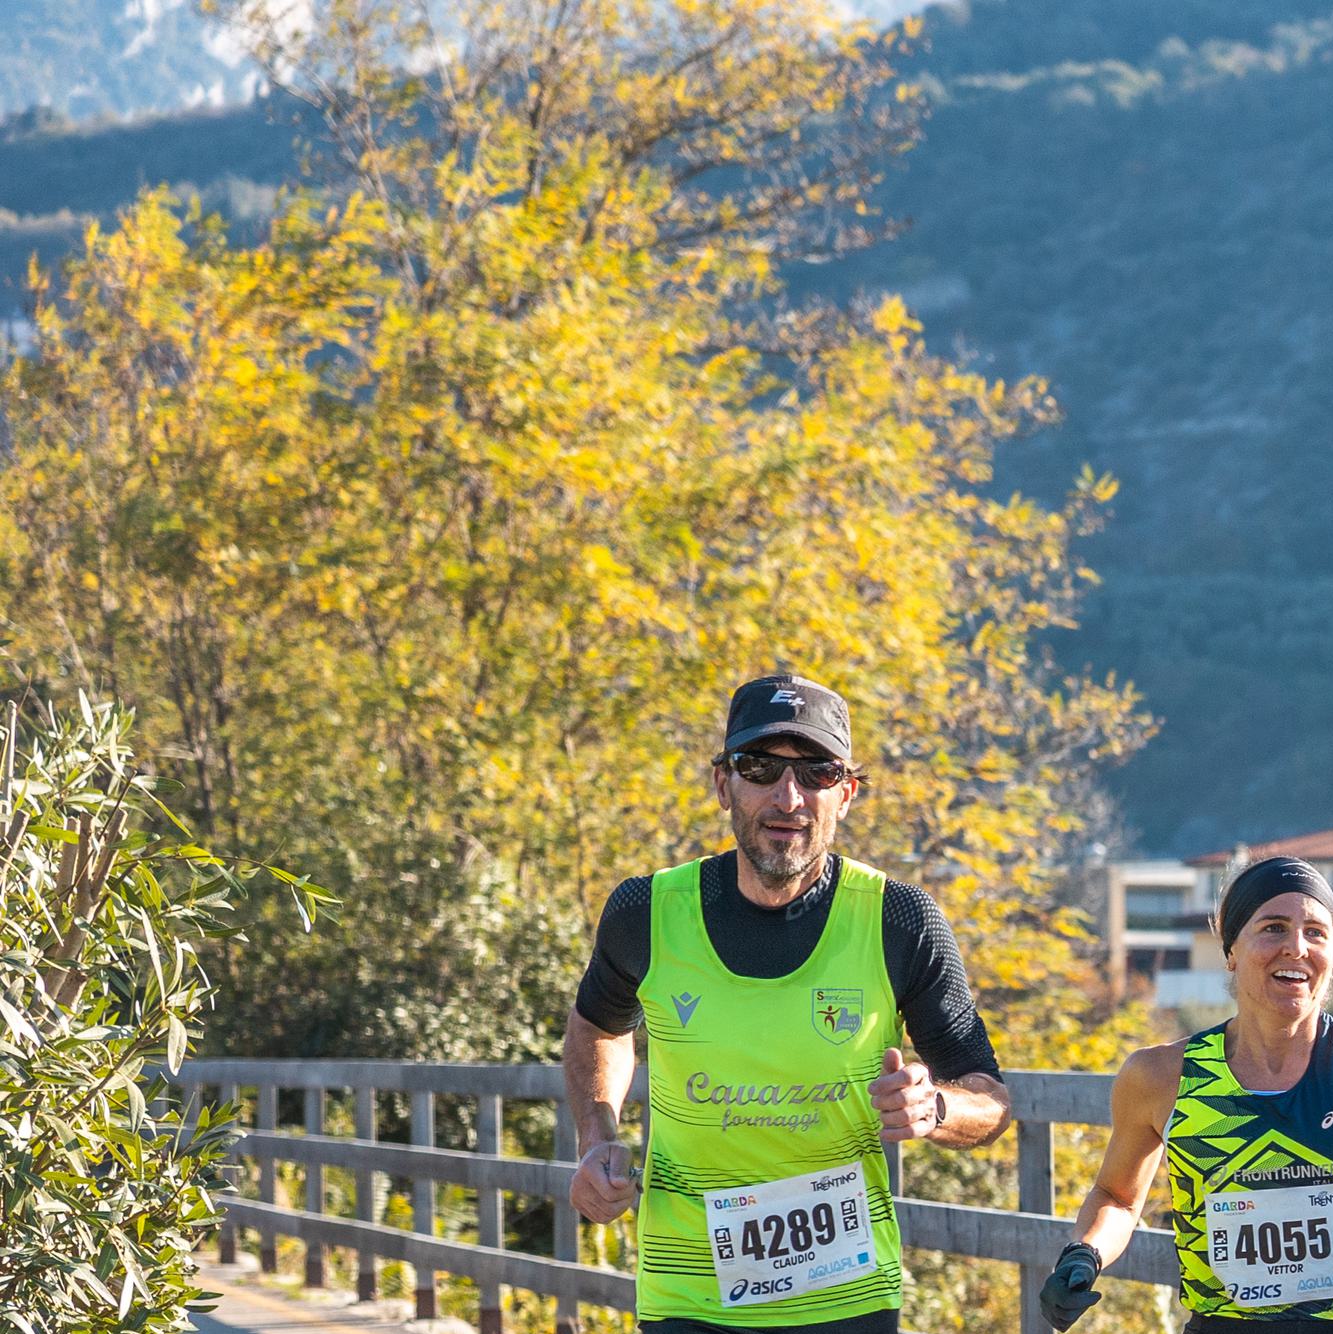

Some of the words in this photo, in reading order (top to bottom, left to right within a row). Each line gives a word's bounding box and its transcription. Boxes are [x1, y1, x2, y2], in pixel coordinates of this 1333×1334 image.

[722, 1108, 820, 1132] formaggi
[810, 1172, 857, 1192] TRENTINO
[714, 1195, 757, 1210] GARDA
[1213, 1200, 1256, 1213] GARDA
[741, 1202, 836, 1261] 4289
[1235, 1218, 1331, 1266] 4055
[773, 1251, 816, 1269] CLAUDIO
[1268, 1264, 1304, 1275] VETTOR
